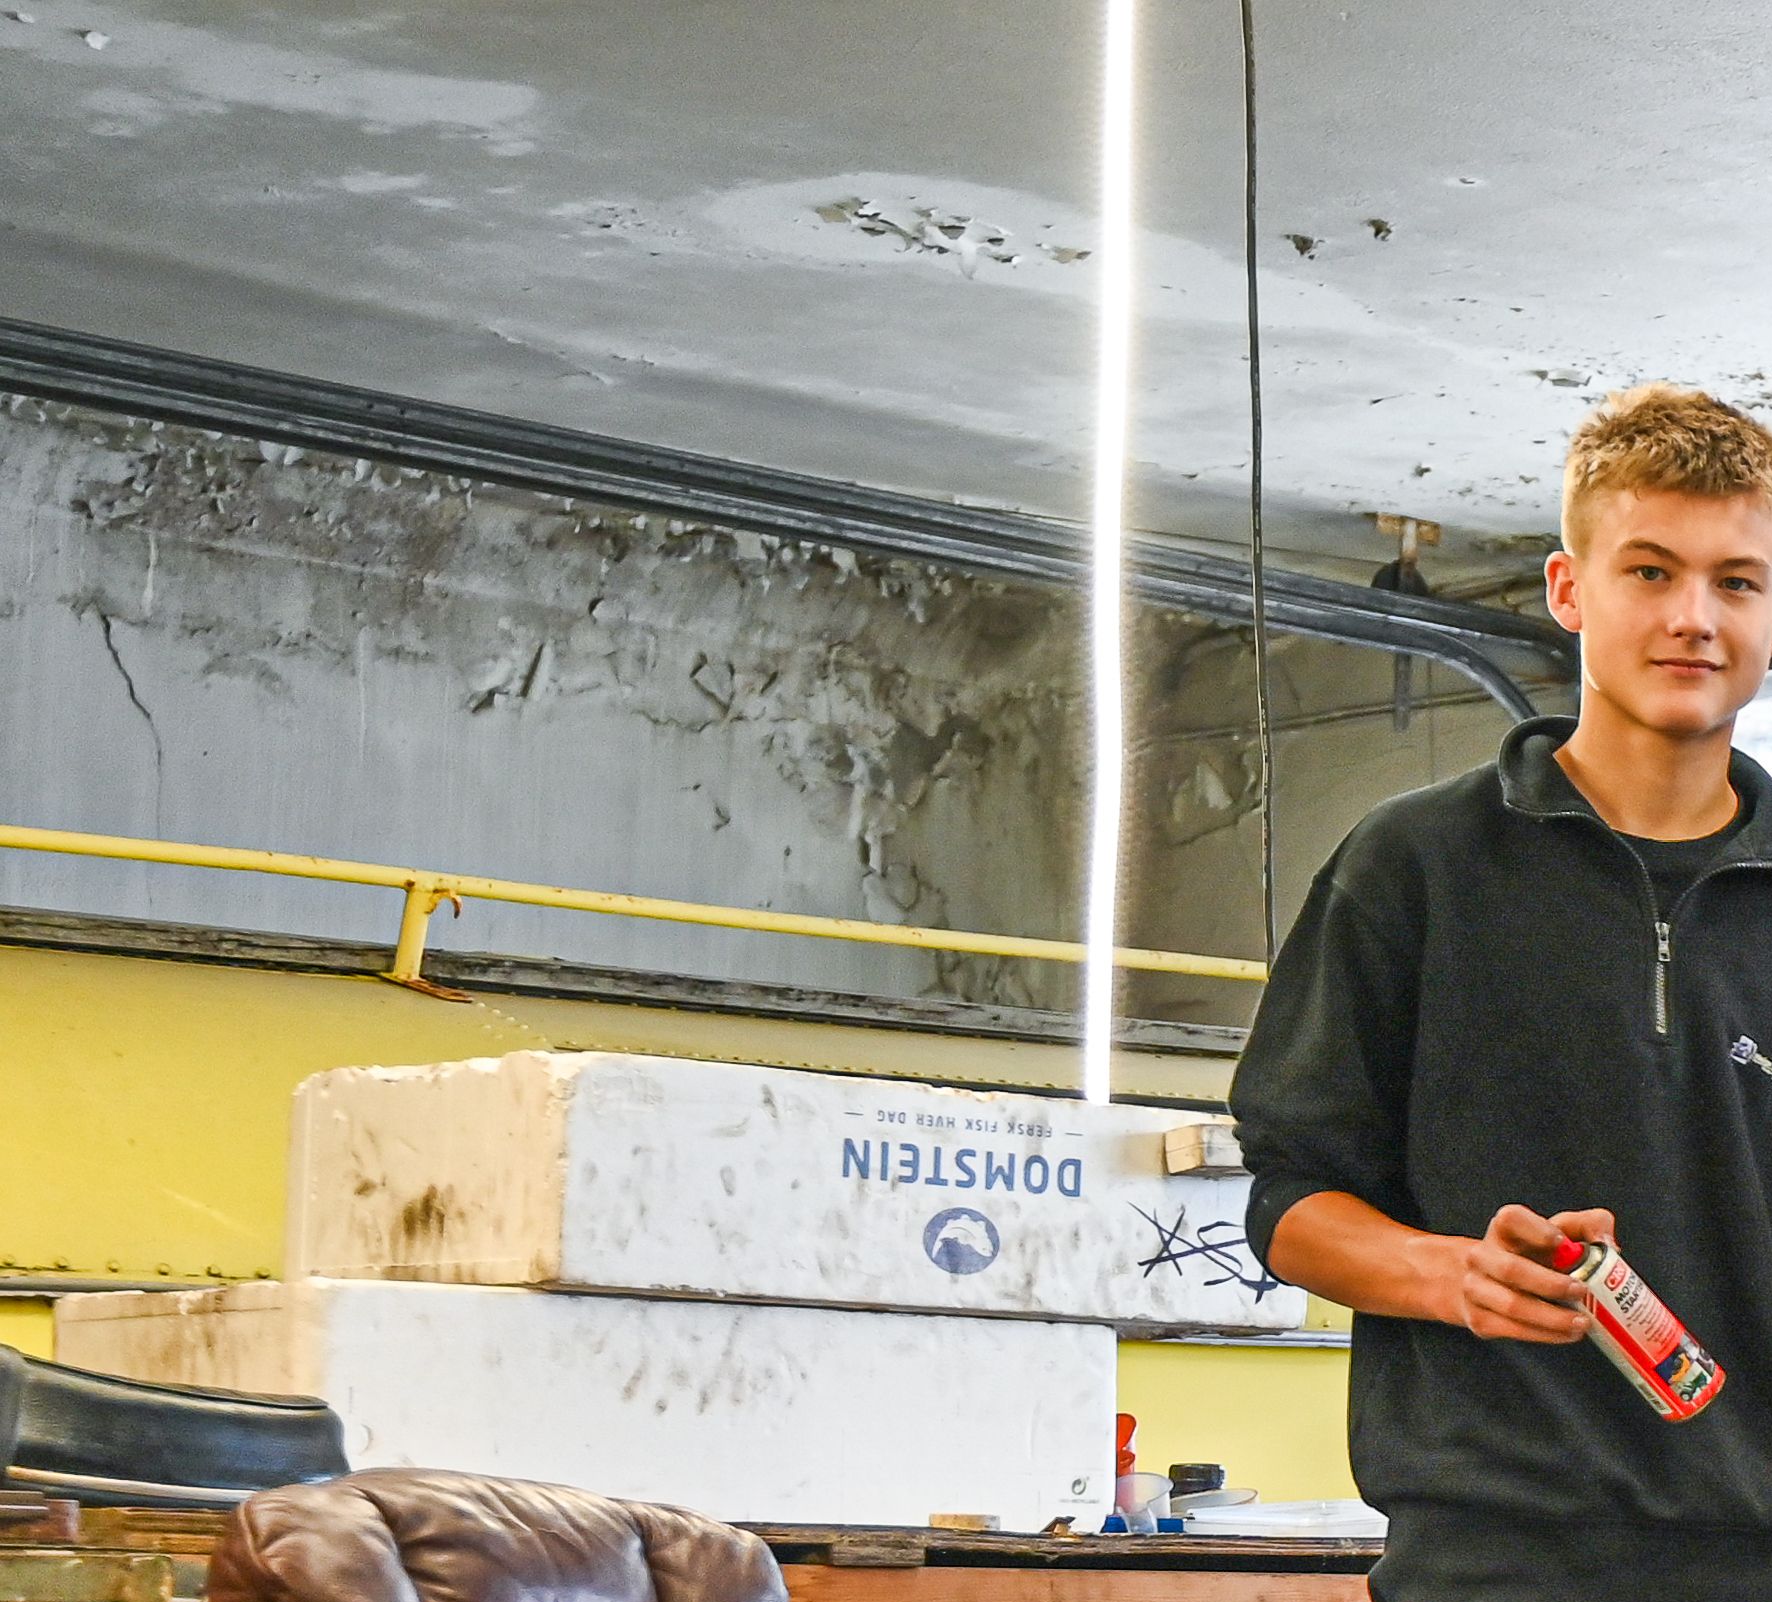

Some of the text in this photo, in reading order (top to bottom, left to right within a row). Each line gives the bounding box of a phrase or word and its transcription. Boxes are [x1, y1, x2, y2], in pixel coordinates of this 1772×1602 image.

[876, 1109, 1052, 1138] FERSK FISK HVER DAG
[842, 1137, 1082, 1198] DOMSTEIN
